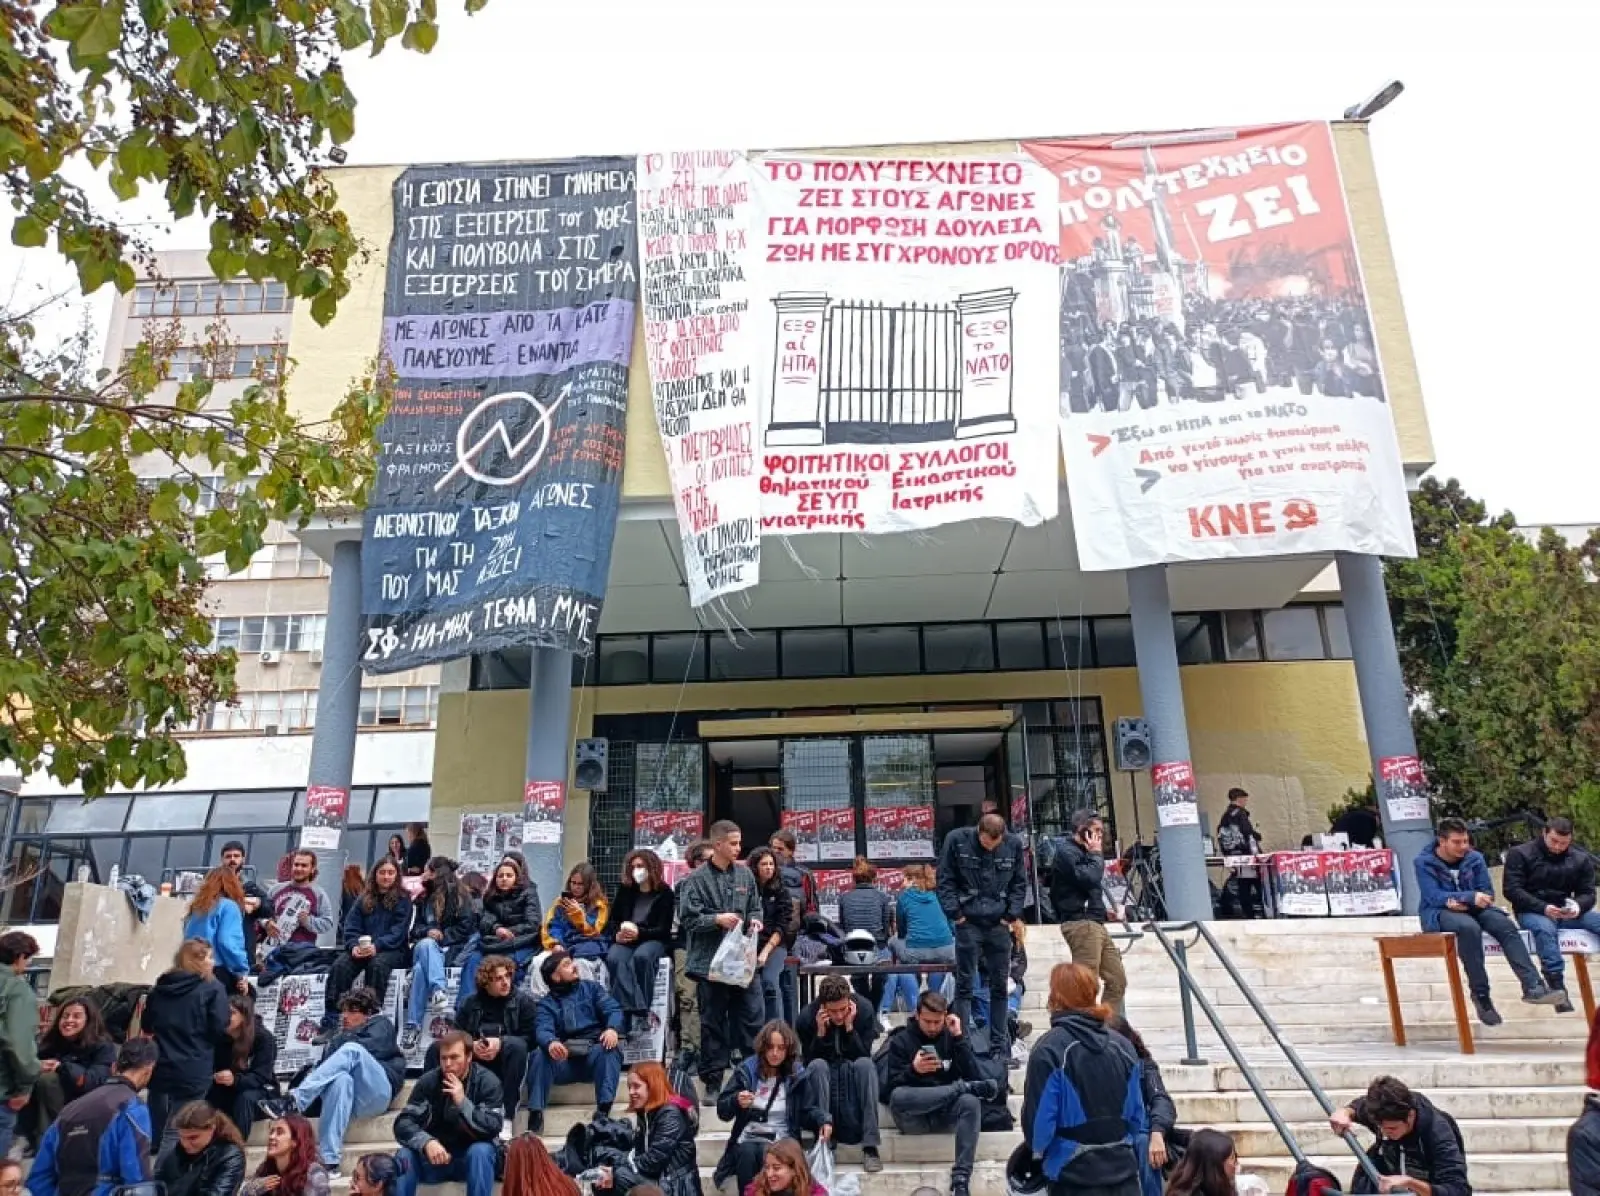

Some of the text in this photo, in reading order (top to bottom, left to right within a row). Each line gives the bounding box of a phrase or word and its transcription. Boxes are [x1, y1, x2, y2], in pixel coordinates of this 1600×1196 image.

[672, 167, 695, 189] ΖΕΙ
[764, 160, 1022, 185] ΤΟ ΠΟΛΥΤΕΧΝΕΙΟ
[1058, 144, 1308, 226] ΠΟΛΥΤΕΧΝΕΙΟ
[1062, 165, 1101, 187] ΤΟ
[402, 170, 636, 208] Η ΕΞΟΥΣΙΑ ΣΤΗΝΕΙ ΜΝΗΜΕΙΑ
[797, 188, 1036, 212] ΖΕΙ ΣΤΟΥΣ ΑΓΩΝΕΣ
[408, 202, 632, 240] ΣΤΙΣ ΕΞΕΓΕΡΣΕΙΣ ΤΟΥ ΧΘΕΣ
[1192, 174, 1320, 244] ΖΕΙ
[767, 216, 1042, 237] ΓΙΑ ΜΟΡΦΩΣΗ ΔΟΥΛΕΙΑ
[406, 234, 600, 270] ΚΑΙ ΠΟΛΥΒΟΛΑ ΣΤΙΣ
[646, 235, 673, 257] ΚΑΤΩ
[766, 241, 1061, 265] ΖΩΗ ΜΕ ΣΥΓΧΡΟΝΟΥΣ ΟΡΟΥΣ
[404, 260, 635, 296] ΕΞΕΓΕΡΣΕΙΣ ΤΟΥ ΣΗΜΕΡΑ
[394, 320, 417, 342] ΜΕ
[429, 317, 492, 340] ΑΓΩΝΕΣ
[503, 313, 534, 335] ΑΠΟ
[548, 311, 561, 332] ΤΑ
[783, 319, 817, 333] ΕΞΩ
[965, 320, 1008, 337] ΕΞΩ
[402, 343, 496, 369] ΠΑΛΕΥΟΥΜΕ
[782, 355, 817, 375] ΗΠΑ
[965, 353, 1010, 375] ΝΑΤΟ
[721, 369, 737, 388] ΚΑΙ
[701, 389, 726, 410] ΔΕΝ
[731, 388, 746, 408] ΘΑ
[1111, 402, 1308, 445] Έξω οι ΗΠΑ και το ΝΑΤΟ
[899, 442, 1009, 471] ΣΥΛΛΟΓΟΙ
[1139, 446, 1175, 464] Από
[1167, 463, 1188, 473] να
[1193, 451, 1254, 472] γίνουμε
[386, 462, 452, 477] ΦΡΑΓΜΟΥΣ
[892, 460, 1017, 490] Εικαστικού
[1238, 466, 1264, 480] για
[1268, 463, 1294, 474] την
[528, 483, 595, 510] ΑΓΩΝΕΣ
[797, 484, 983, 513] ΣΕΥΠ Ιατρικής
[1187, 501, 1277, 539] ΚΝΕ
[415, 547, 438, 569] ΓΙΑ
[450, 542, 475, 567] ΤΗ
[382, 573, 412, 600] ΠΟΥ
[426, 569, 464, 597] ΜΑΣ
[552, 595, 597, 644] ΜΜΕ
